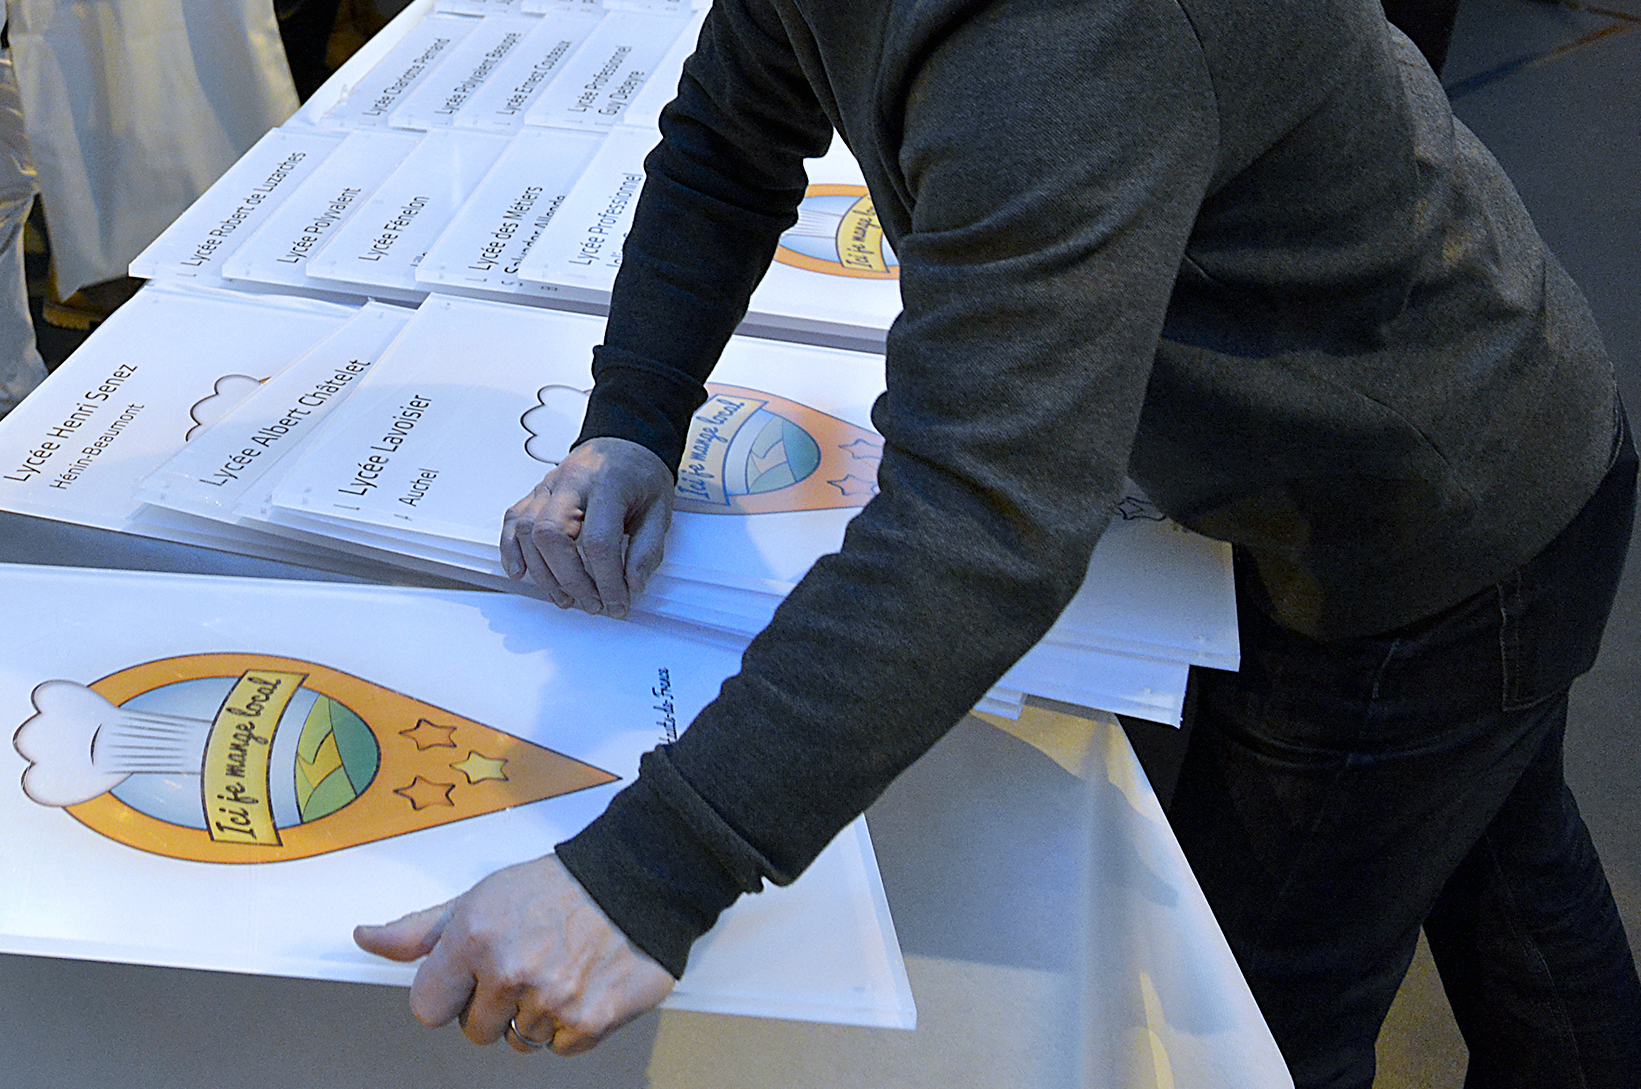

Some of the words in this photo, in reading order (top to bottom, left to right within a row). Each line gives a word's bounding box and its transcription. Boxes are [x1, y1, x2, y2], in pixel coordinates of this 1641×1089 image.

[362, 96, 395, 116] Lycée
[383, 65, 425, 95] Charlotte
[434, 94, 467, 115] Lycée
[453, 58, 499, 93] Polyvalent
[495, 94, 528, 115] Lycée
[514, 70, 547, 94] Ernest
[567, 92, 599, 113] Lycée
[584, 45, 633, 91] Professionnel
[252, 151, 307, 193] Luzarches
[209, 205, 255, 238] Robert
[242, 192, 267, 210] de
[502, 185, 543, 222] Métiers
[568, 241, 606, 267] Lycée
[588, 172, 645, 236] Professionnel
[276, 235, 318, 264] Lycée
[303, 186, 362, 235] Polyvalent
[358, 232, 399, 262] Lycée
[383, 194, 431, 235] Fénelon
[490, 221, 520, 241] des
[180, 238, 223, 266] Lycée
[468, 240, 506, 272] Lycée
[2, 441, 62, 482] Lycée
[46, 402, 99, 439] Henri
[84, 363, 139, 402] Senez
[199, 447, 262, 487] Lycée
[251, 407, 312, 448] Albert
[298, 359, 371, 408] Châtelet
[696, 397, 746, 428] local
[48, 402, 146, 490] Hénin-Beaumont
[338, 454, 390, 496] Lycée
[370, 394, 433, 453] Lavoisier
[689, 425, 727, 462] mange
[398, 468, 440, 508] Auchel
[677, 477, 711, 500] Ici
[679, 461, 716, 479] je
[225, 676, 282, 718] local
[224, 720, 269, 779] mange
[216, 781, 259, 805] je
[214, 806, 258, 840] Ici
